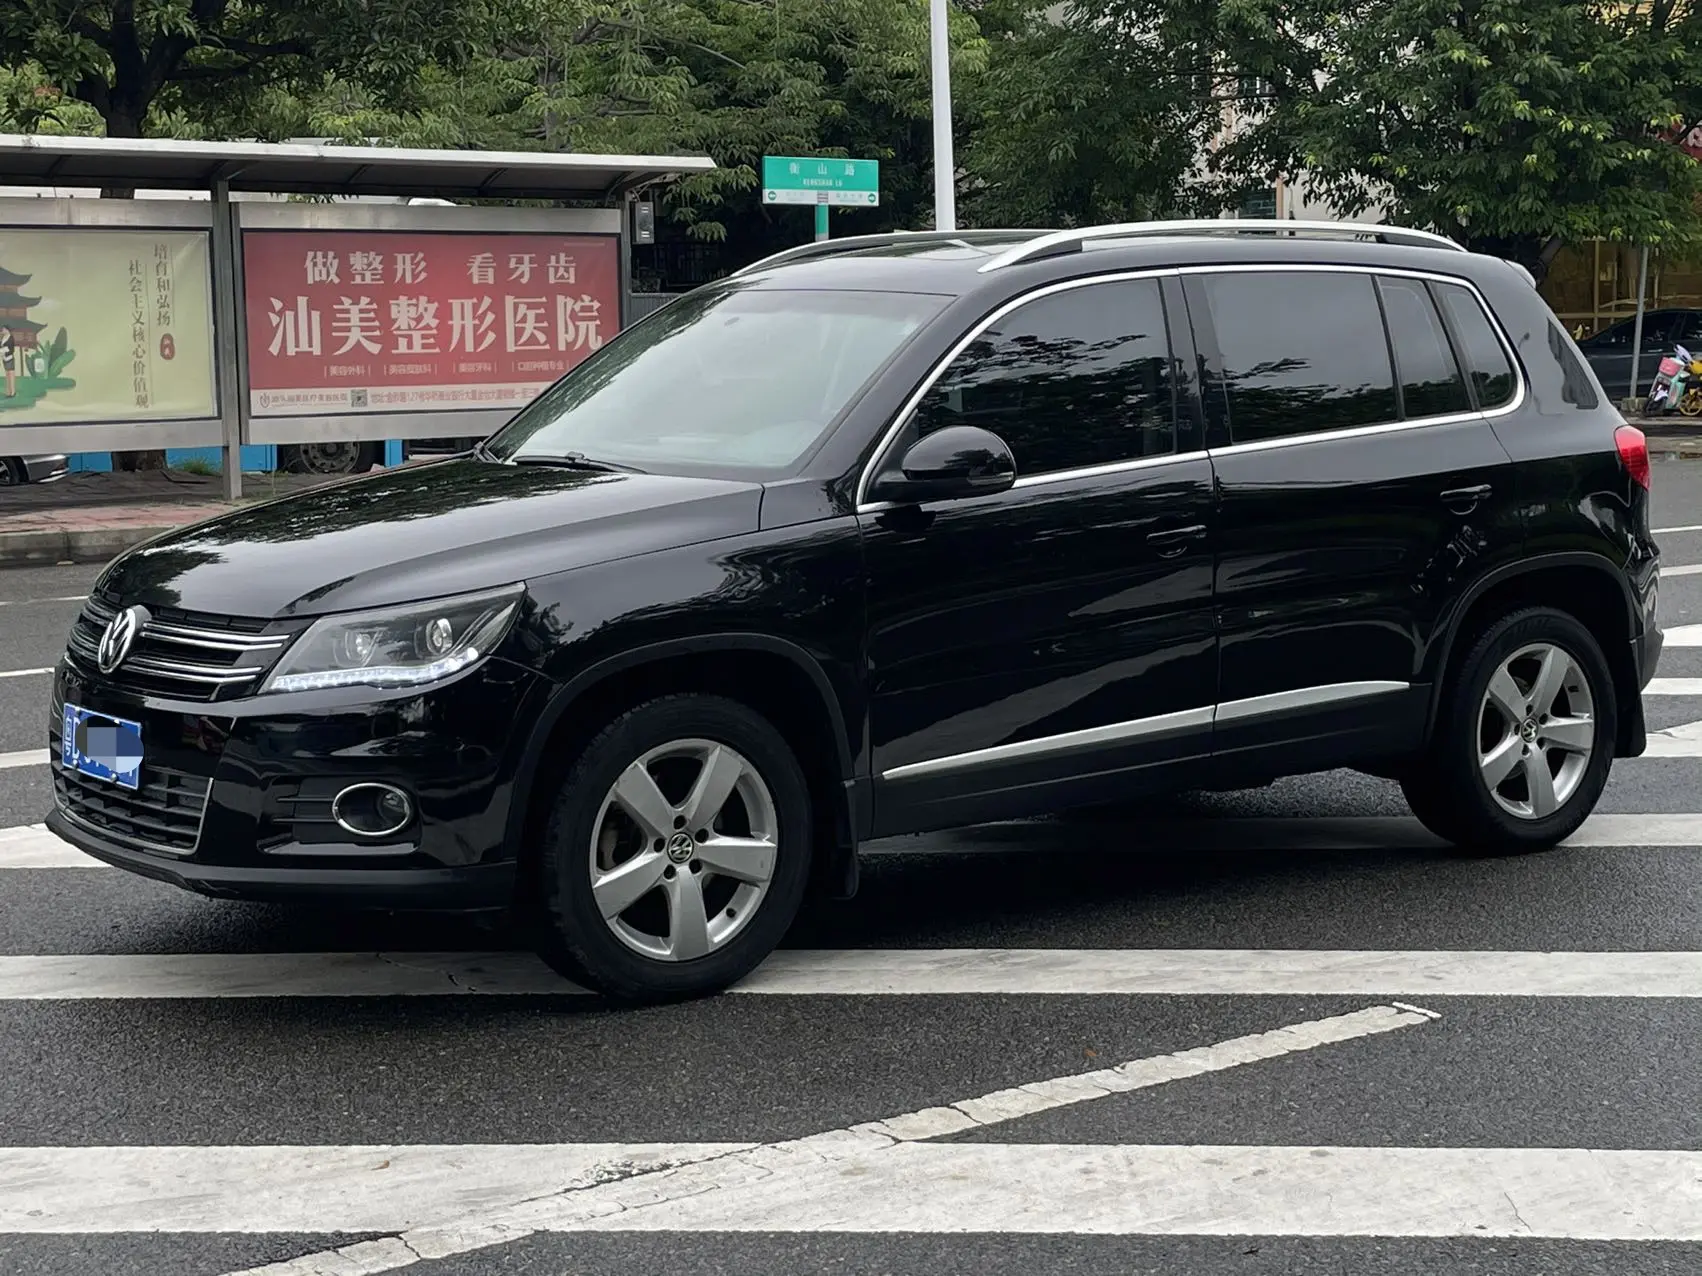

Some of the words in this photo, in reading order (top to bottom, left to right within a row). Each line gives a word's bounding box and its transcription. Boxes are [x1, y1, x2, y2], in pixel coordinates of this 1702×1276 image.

[154, 243, 171, 326] 培育和弘扬
[304, 250, 427, 285] 做整形
[467, 252, 577, 285] 看牙齿
[129, 259, 149, 408] 社会主义核心价值观
[267, 294, 603, 356] 汕美整形医院
